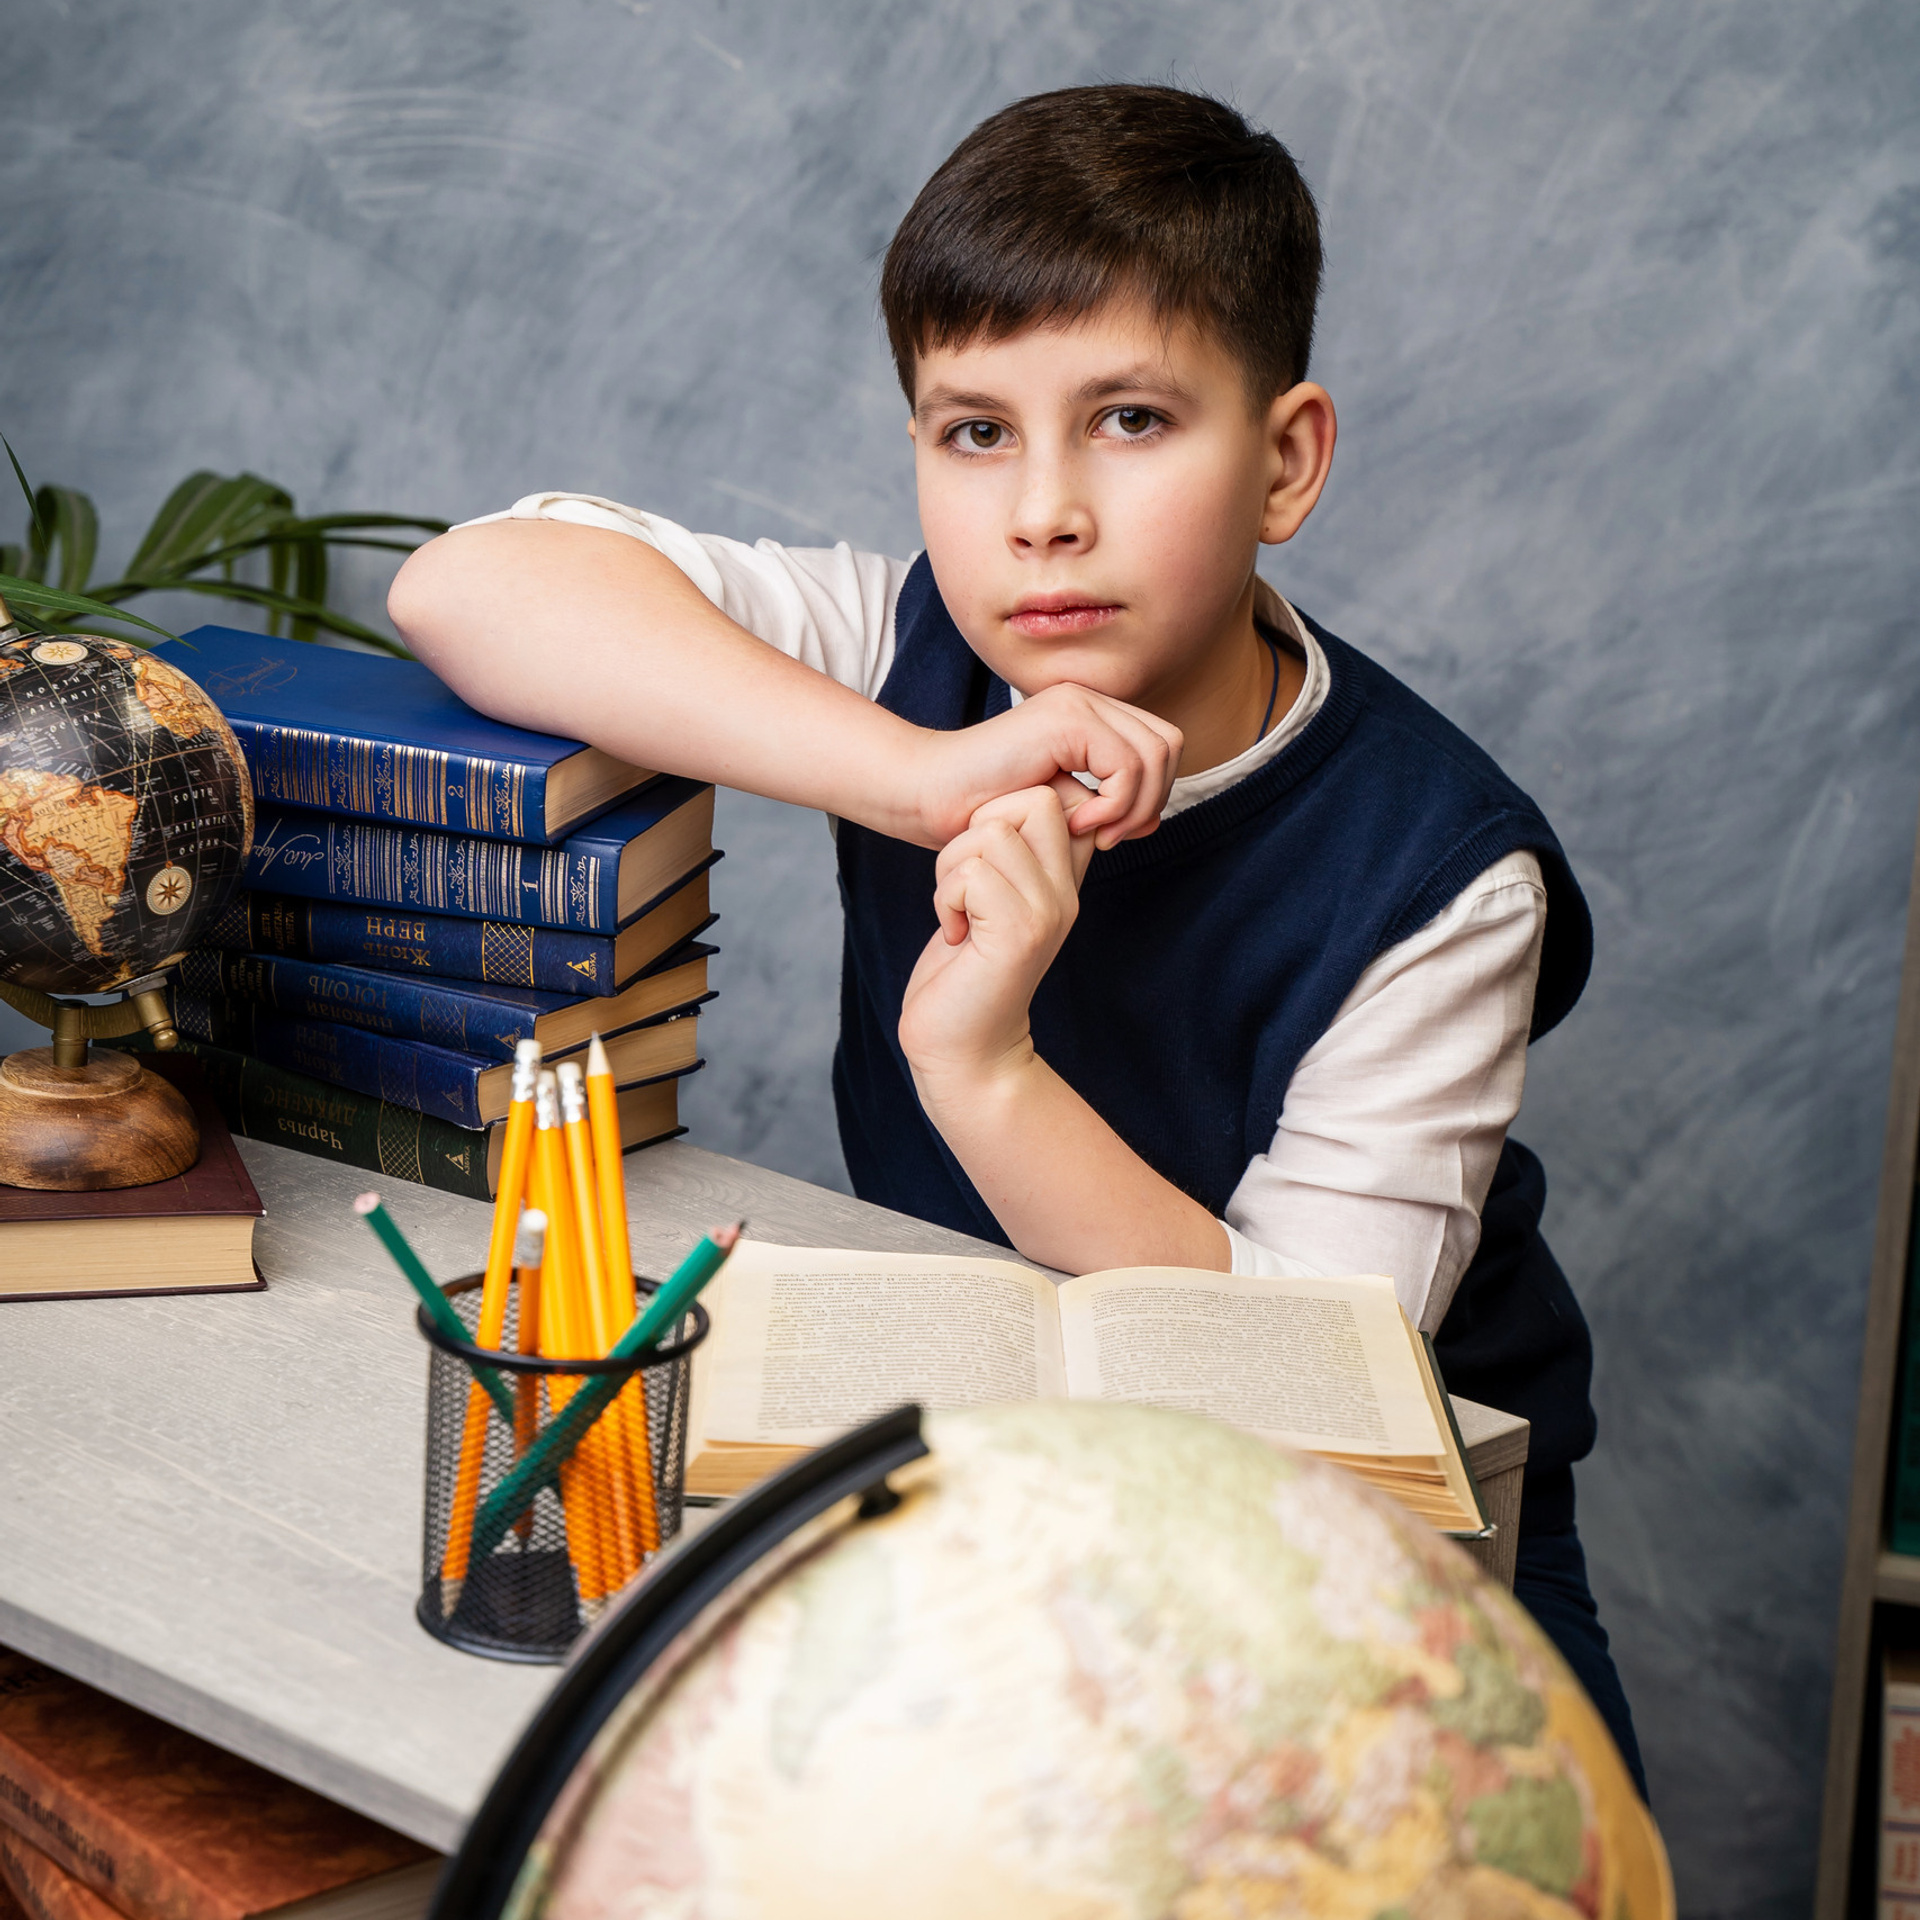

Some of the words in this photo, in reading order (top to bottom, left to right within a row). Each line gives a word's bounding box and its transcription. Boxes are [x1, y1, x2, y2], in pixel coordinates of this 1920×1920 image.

[25, 676, 81, 699] NORTH
[30, 684, 108, 716] ATLANTIC
[49, 711, 102, 733] OCEAN
[173, 787, 214, 805] SOUTH
[447, 784, 465, 799] 2
[174, 814, 227, 835] ATLANTIC
[178, 837, 220, 856] OCEAN
[521, 879, 541, 894] 1
[365, 915, 427, 942] ВЕРН
[362, 942, 431, 967] Жюль
[307, 975, 388, 1010] ГОГОЛЬ
[304, 1000, 393, 1032] Николай
[295, 1024, 339, 1055] ВЕРН
[290, 1049, 345, 1081] Жюль
[262, 1085, 358, 1127] ДИККЕНС
[276, 1117, 344, 1151] Чарльз
